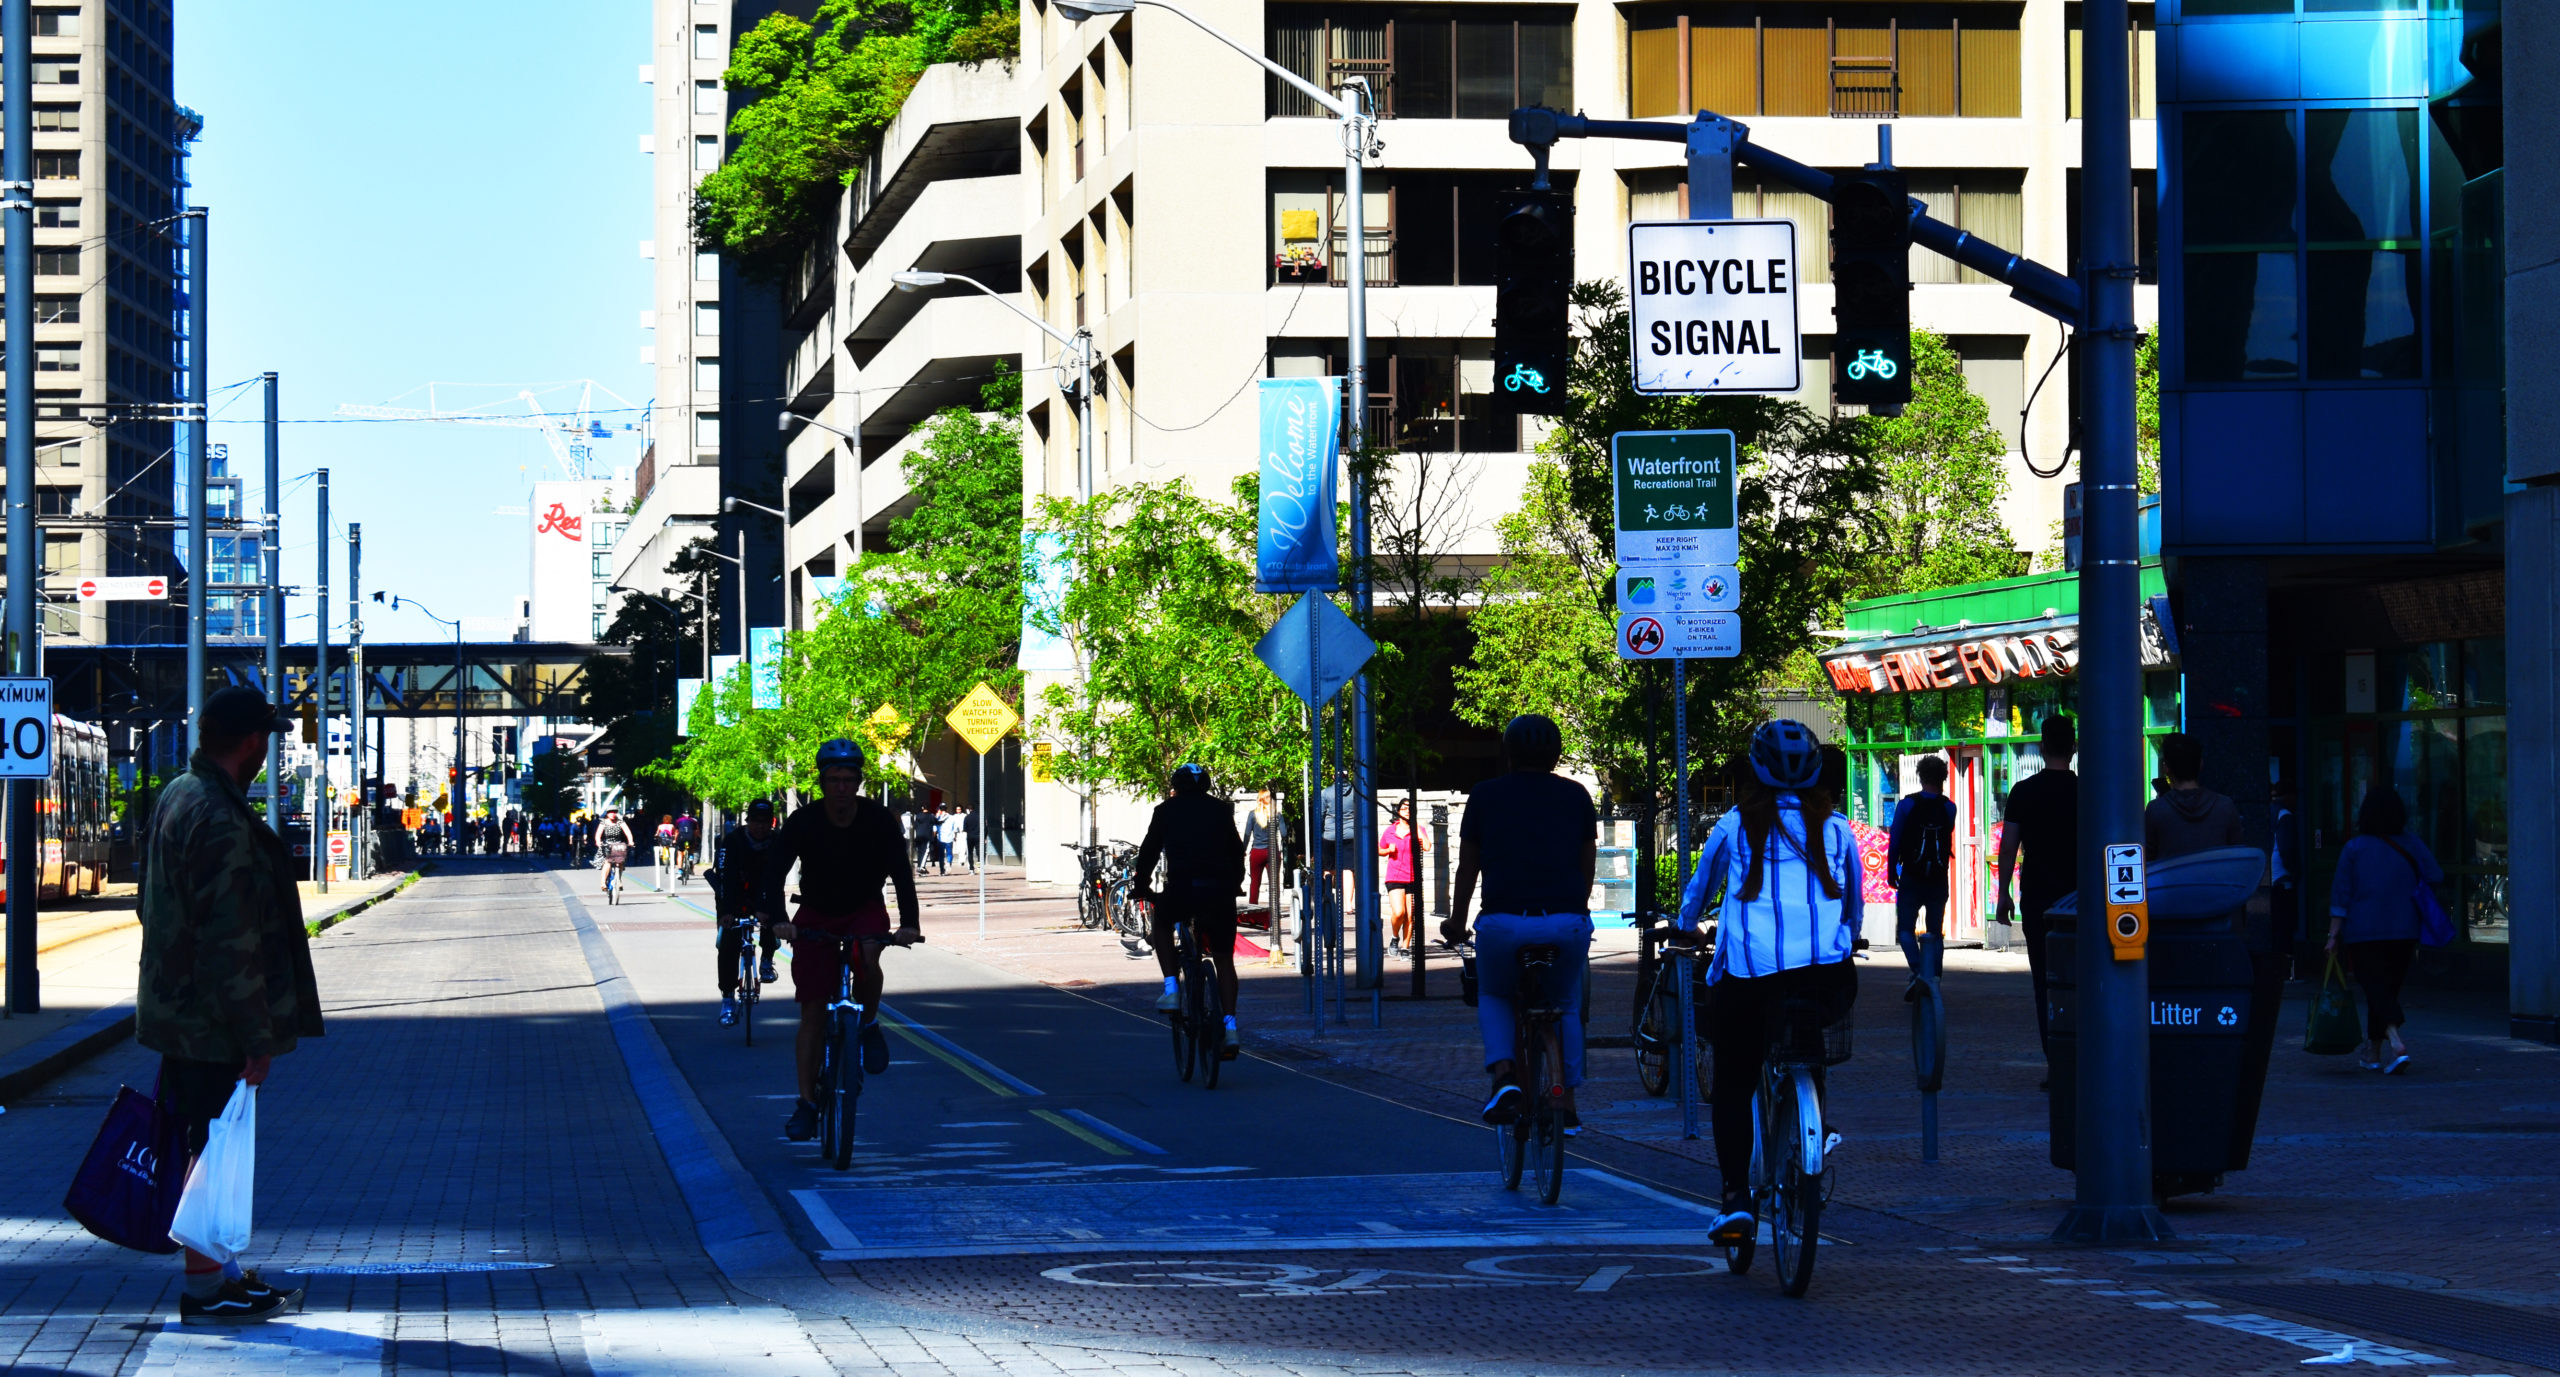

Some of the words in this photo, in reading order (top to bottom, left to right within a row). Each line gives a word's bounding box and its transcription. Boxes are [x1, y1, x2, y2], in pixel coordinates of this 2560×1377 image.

[1639, 258, 1788, 296] BICYCLE
[1650, 319, 1782, 357] SIGNAL
[1307, 401, 1317, 460] Waterfront
[1266, 394, 1307, 550] Welcome
[1308, 463, 1316, 481] the
[1627, 456, 1721, 476] Waterfront
[1308, 484, 1316, 497] to
[1633, 479, 1694, 490] Recreational
[1695, 477, 1717, 489] Trail
[1881, 647, 1958, 692] FINE
[1956, 631, 2079, 685] FOODS
[961, 708, 988, 717] WATCH
[988, 708, 1003, 717] FOR
[972, 699, 993, 707] SLOW
[966, 718, 999, 727] TURNING
[966, 727, 1000, 735] VEHICLES
[2150, 1001, 2202, 1025] Litter
